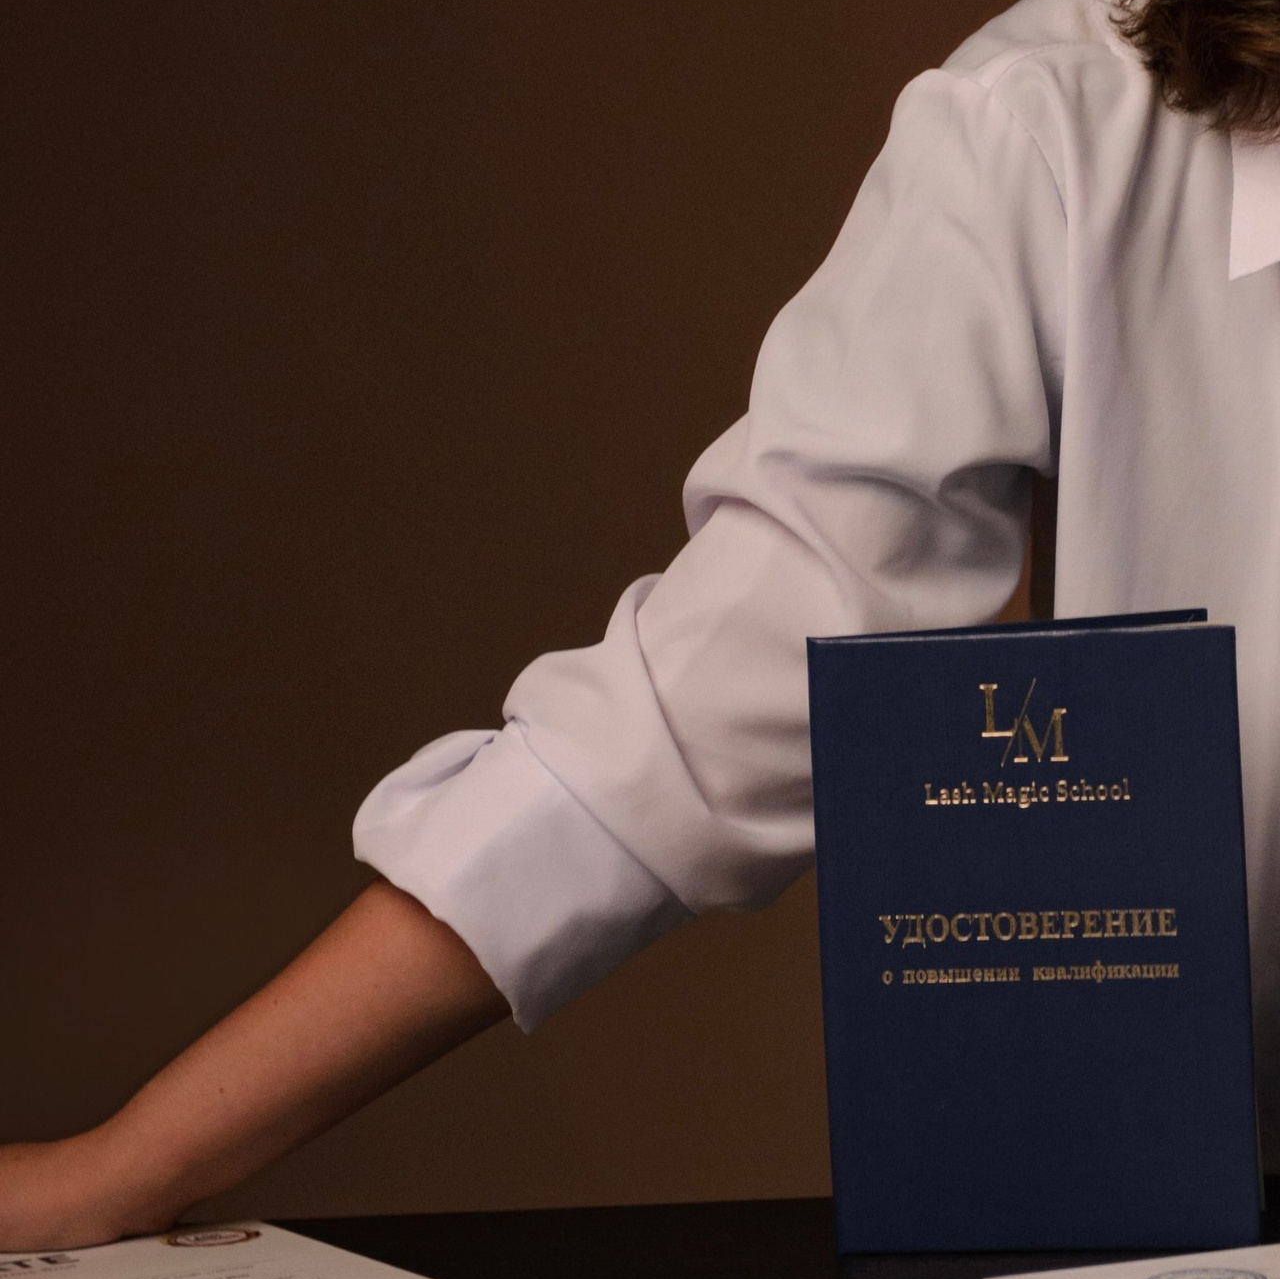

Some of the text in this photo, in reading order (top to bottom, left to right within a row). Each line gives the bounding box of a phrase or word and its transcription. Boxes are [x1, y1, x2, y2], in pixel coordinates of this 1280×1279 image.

[924, 778, 1131, 809] Lash Magic School
[878, 908, 1178, 949] УДОСТОВЕРЕНИЕ
[881, 959, 1180, 985] о повышении квалификации
[0, 1252, 80, 1273] TE
